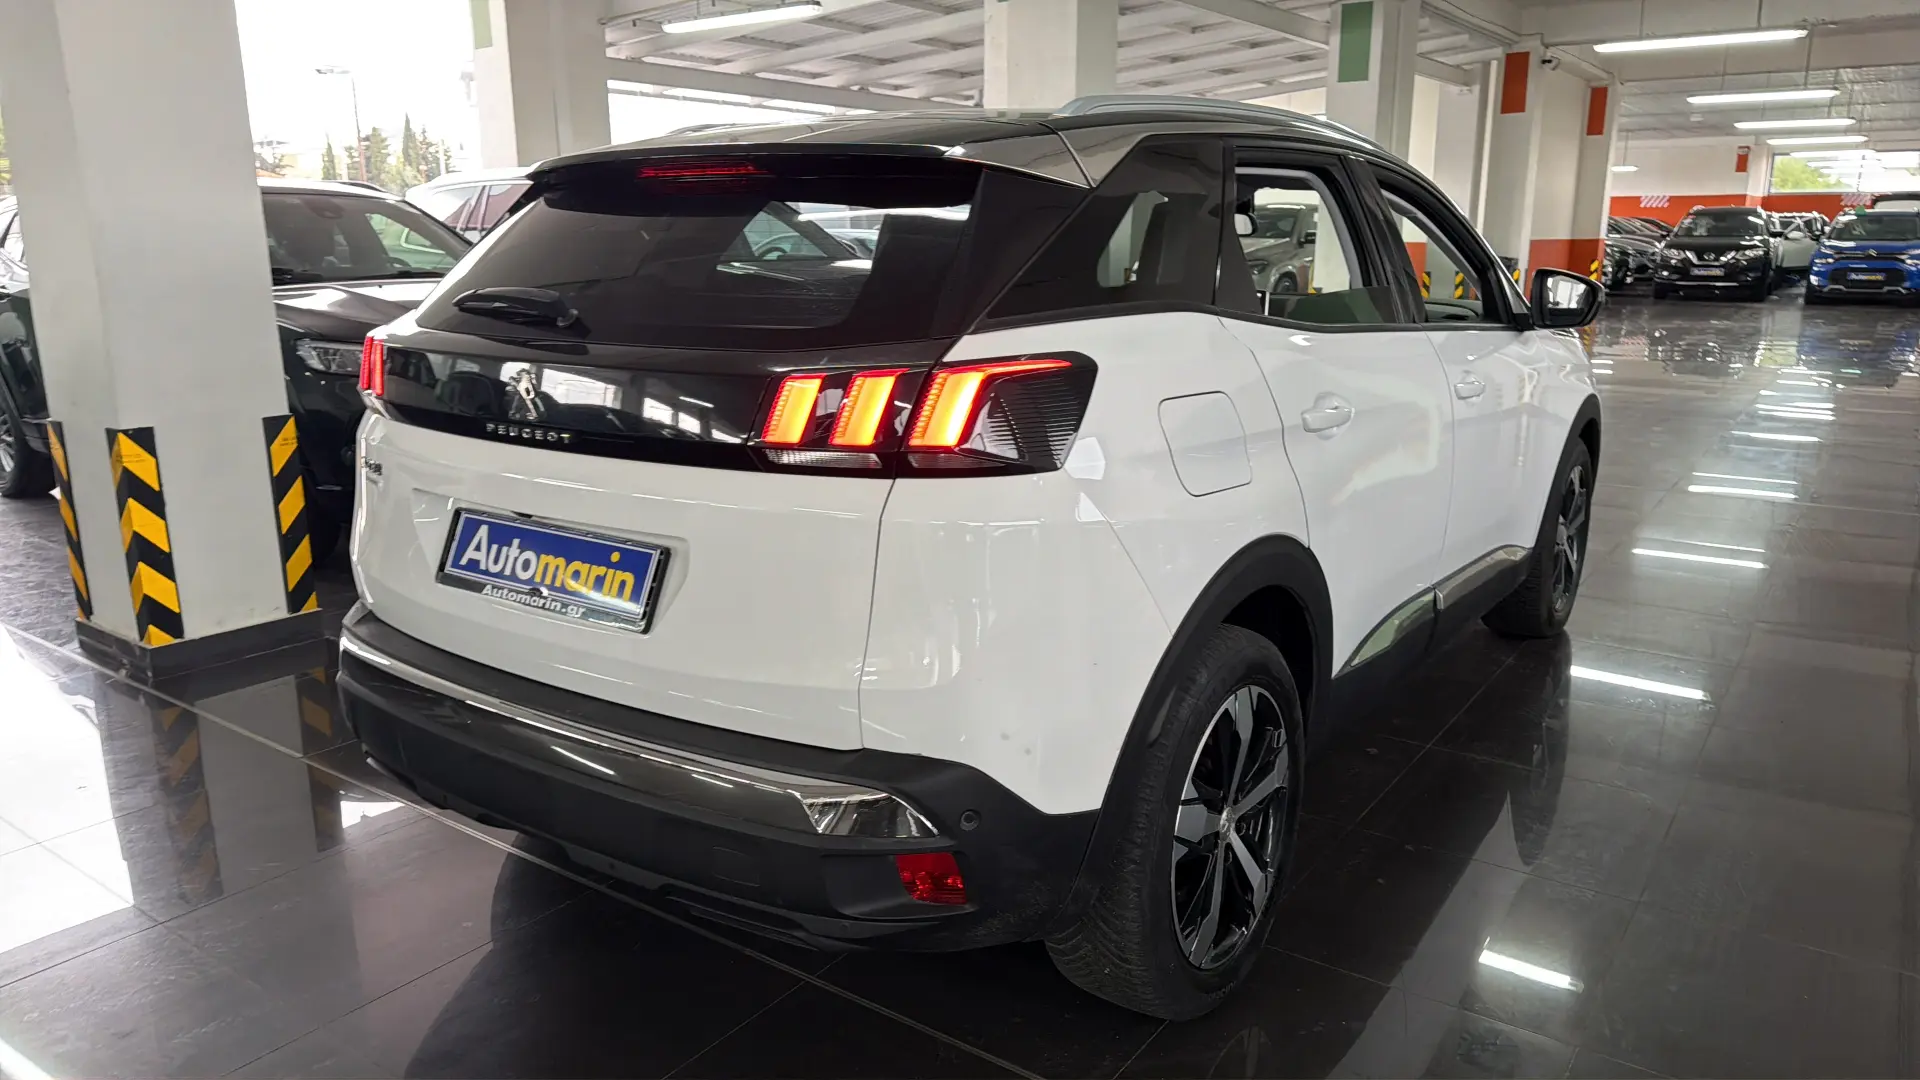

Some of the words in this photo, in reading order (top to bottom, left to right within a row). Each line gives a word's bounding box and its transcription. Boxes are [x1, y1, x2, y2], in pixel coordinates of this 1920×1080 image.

[486, 423, 571, 444] PEUGEOT
[459, 524, 635, 602] Automarin
[481, 584, 587, 618] Automarin.gr
